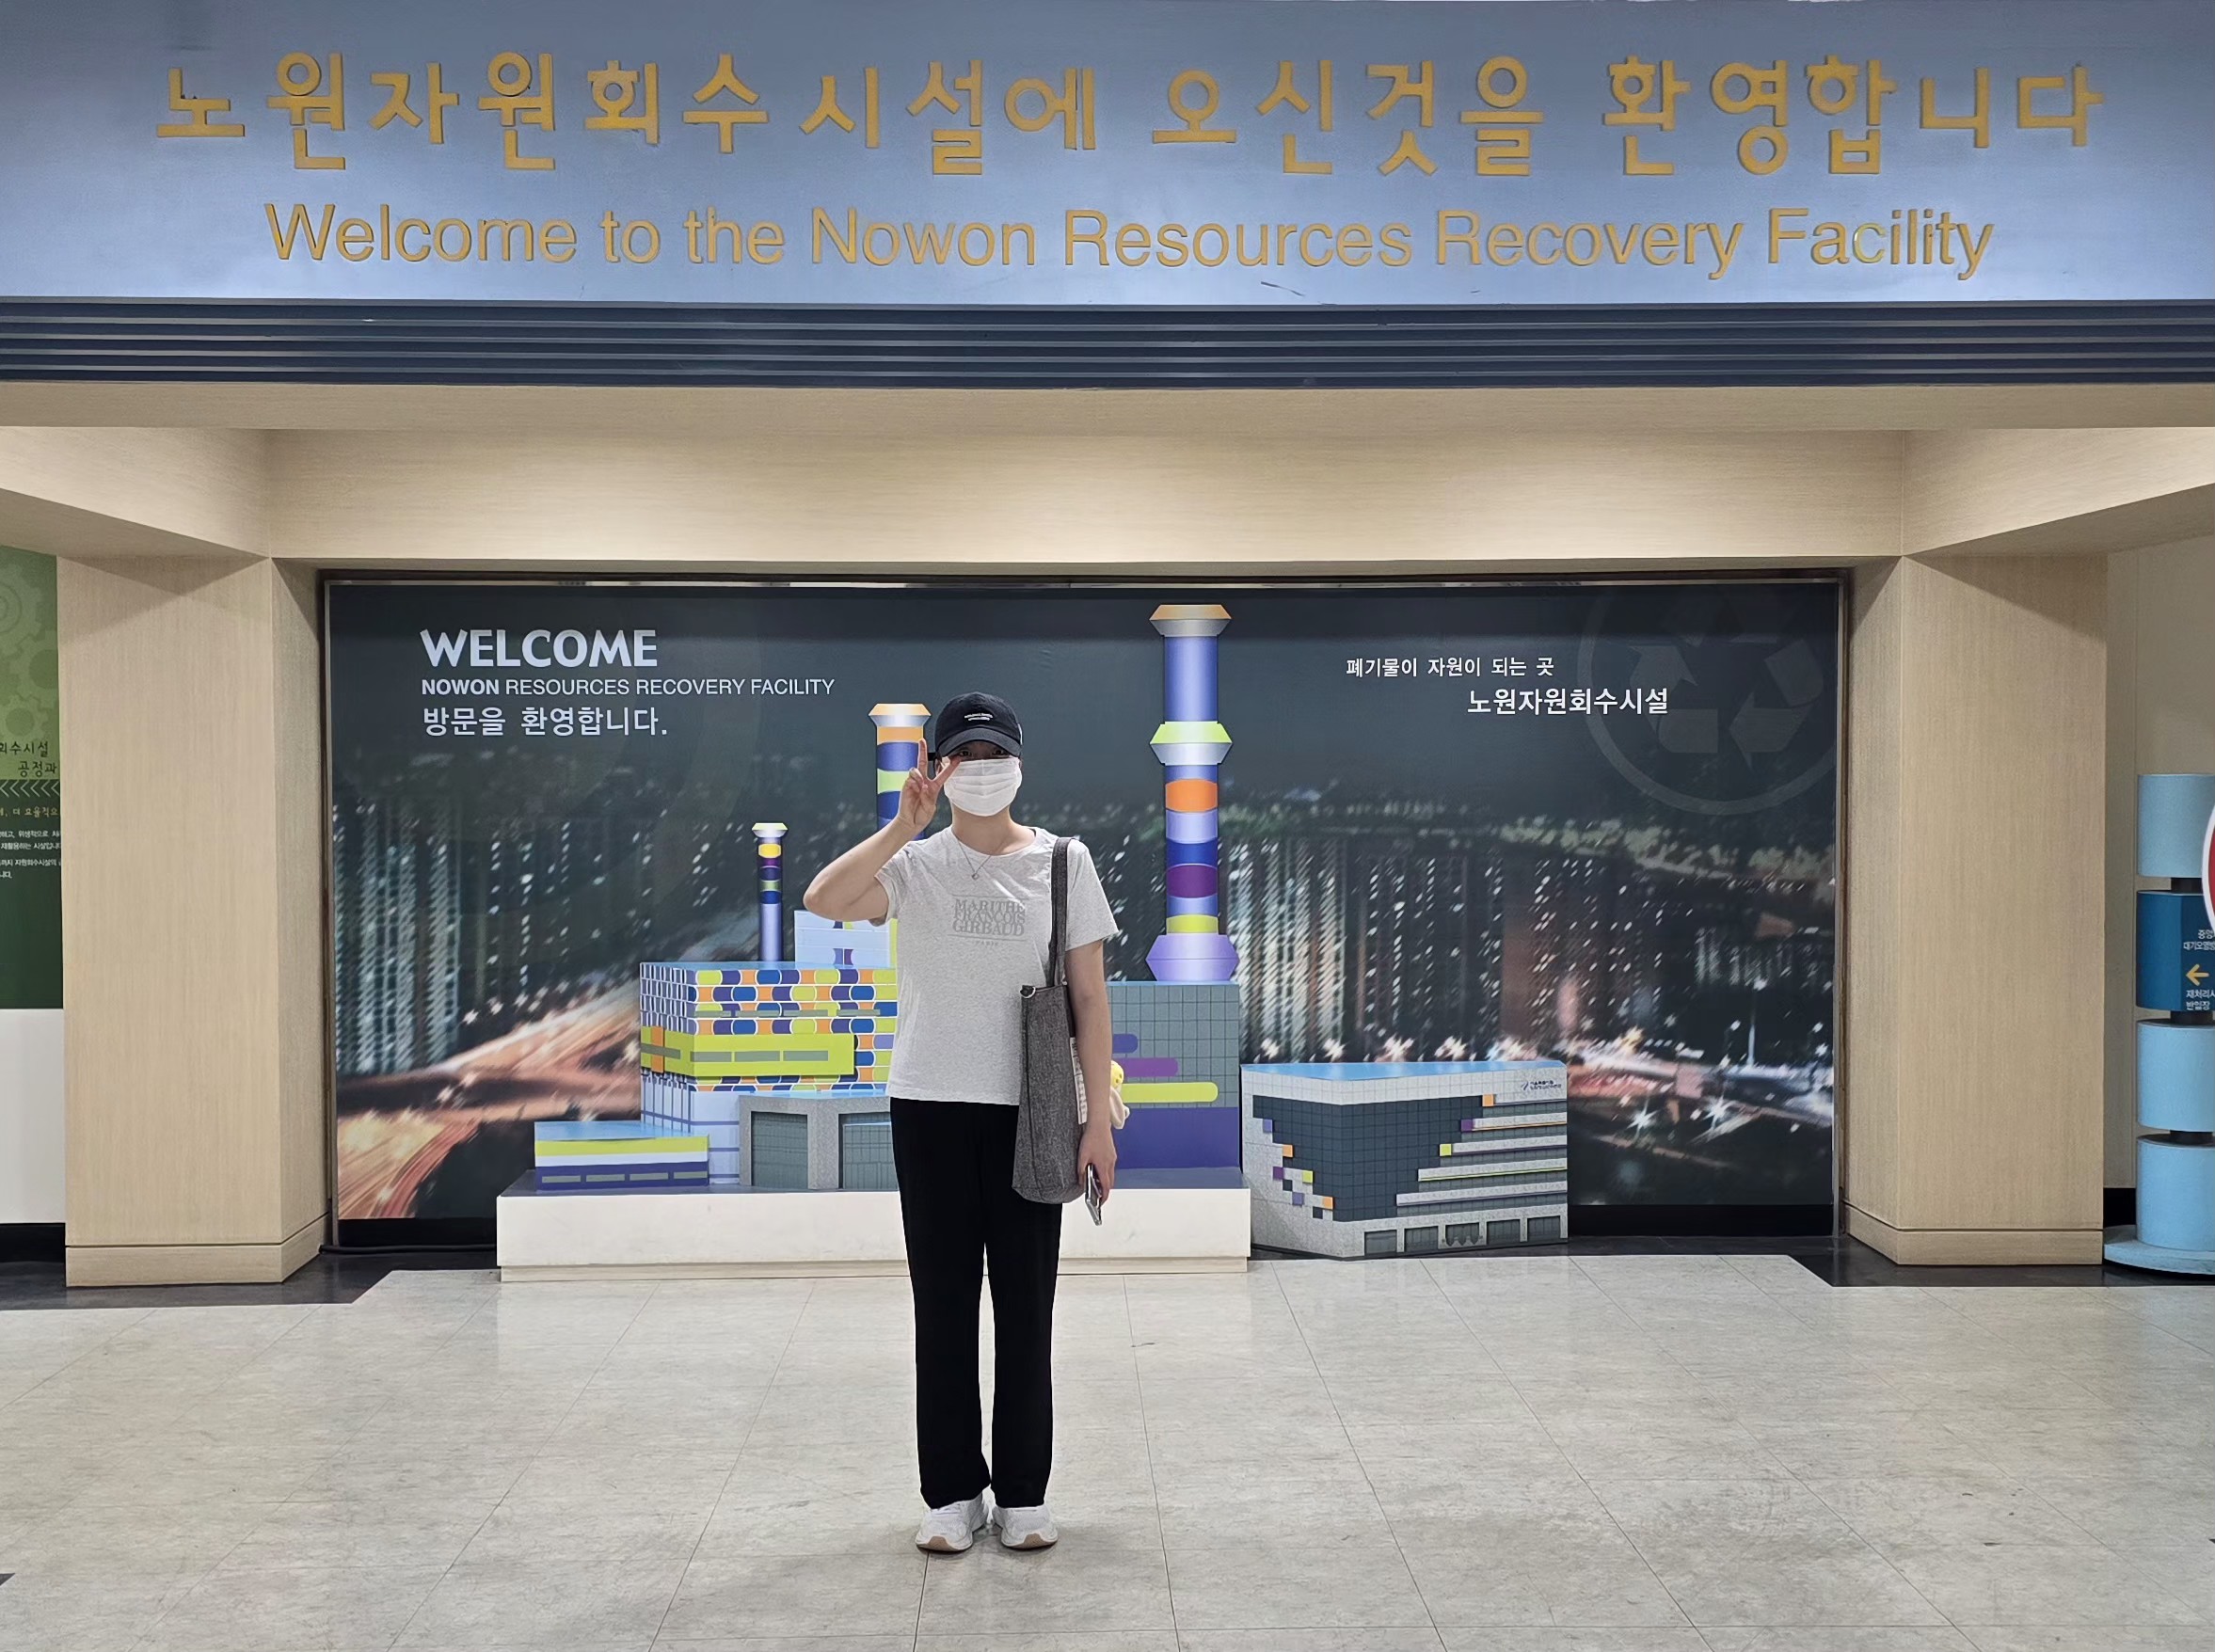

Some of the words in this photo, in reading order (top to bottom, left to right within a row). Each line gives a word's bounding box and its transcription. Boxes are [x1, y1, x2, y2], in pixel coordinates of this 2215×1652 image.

[156, 53, 1097, 176] 노원자원회수시설에
[1153, 56, 1544, 177] 오신것을
[1603, 55, 2104, 177] 환영합니다
[267, 203, 577, 263] Welcome
[602, 212, 661, 263] to
[686, 208, 785, 265] the
[812, 209, 1037, 267] Nowon
[1065, 210, 1412, 268] Resources
[1437, 210, 1745, 280] Recovery
[1769, 208, 1994, 280] Facility
[420, 629, 659, 668] WELCOME
[1347, 658, 1418, 678] 폐기물이
[1427, 658, 1482, 677] 자원이
[1491, 657, 1528, 677] 되는
[1537, 657, 1555, 677] 곳
[422, 678, 501, 696] NOWON
[505, 678, 630, 696] RESOURCES
[636, 678, 746, 696] RECOVERY
[751, 678, 837, 696] FACILITY
[1467, 688, 1669, 716] 노원자원회수시설
[422, 707, 507, 738] 방문을
[520, 707, 669, 738] 환영합니다.
[18, 760, 57, 778] 공정과
